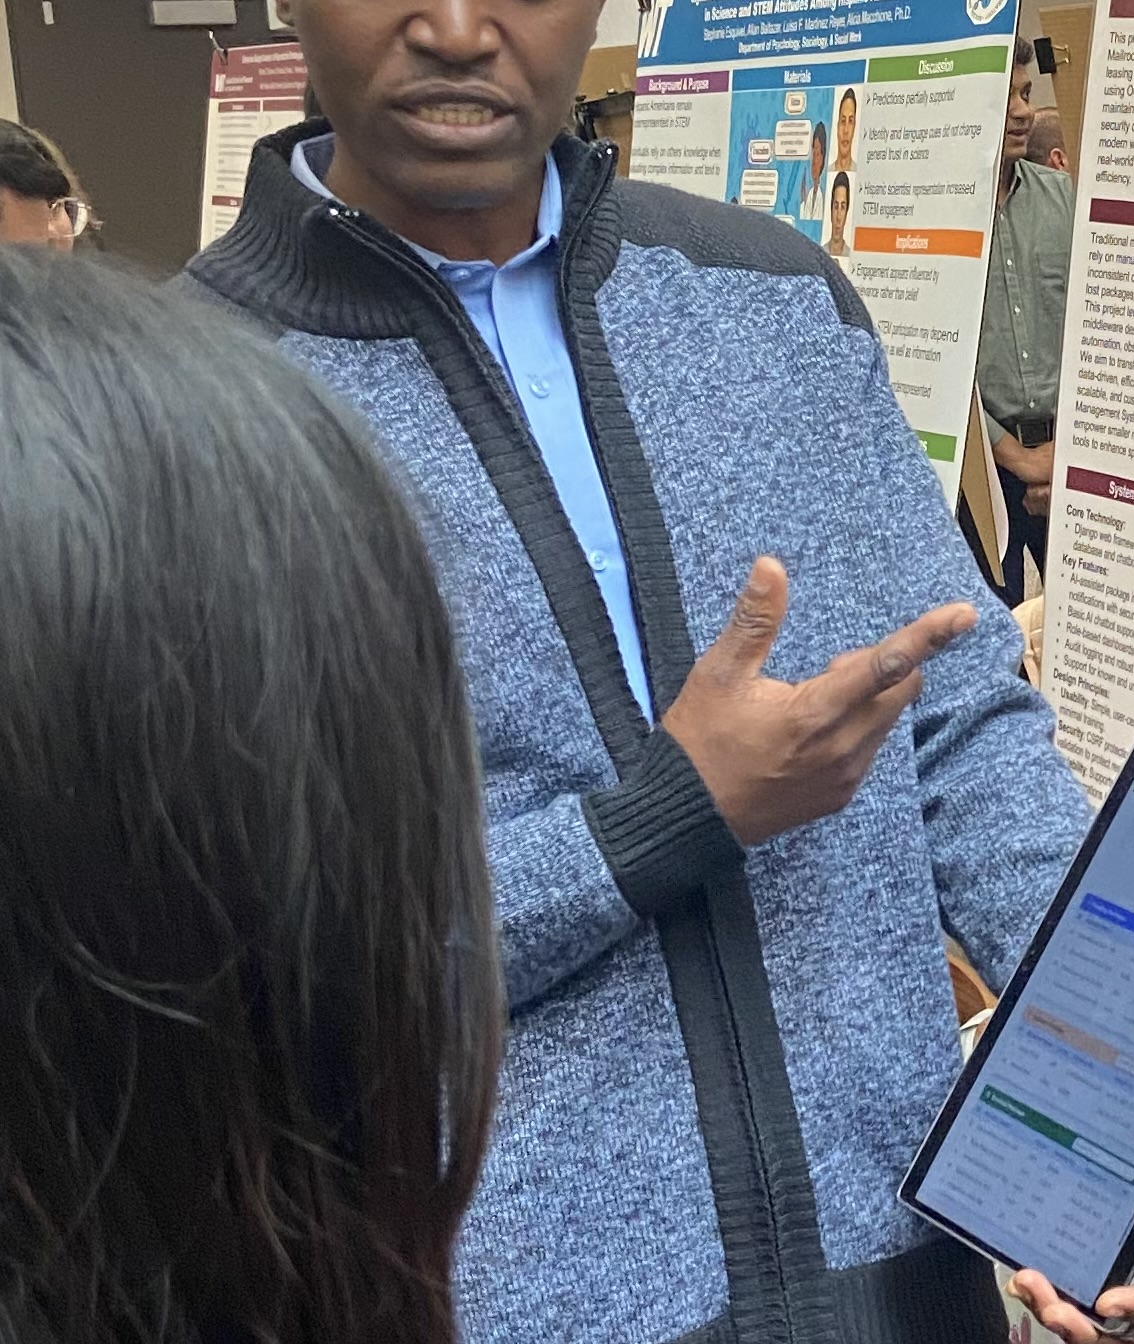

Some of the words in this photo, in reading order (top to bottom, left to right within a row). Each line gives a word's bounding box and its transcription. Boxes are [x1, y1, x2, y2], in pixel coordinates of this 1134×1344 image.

[712, 6, 738, 21] Science
[739, 2, 752, 18] and
[753, 0, 773, 16] STEM
[1067, 503, 1085, 519] Core
[1063, 553, 1077, 570] Key
